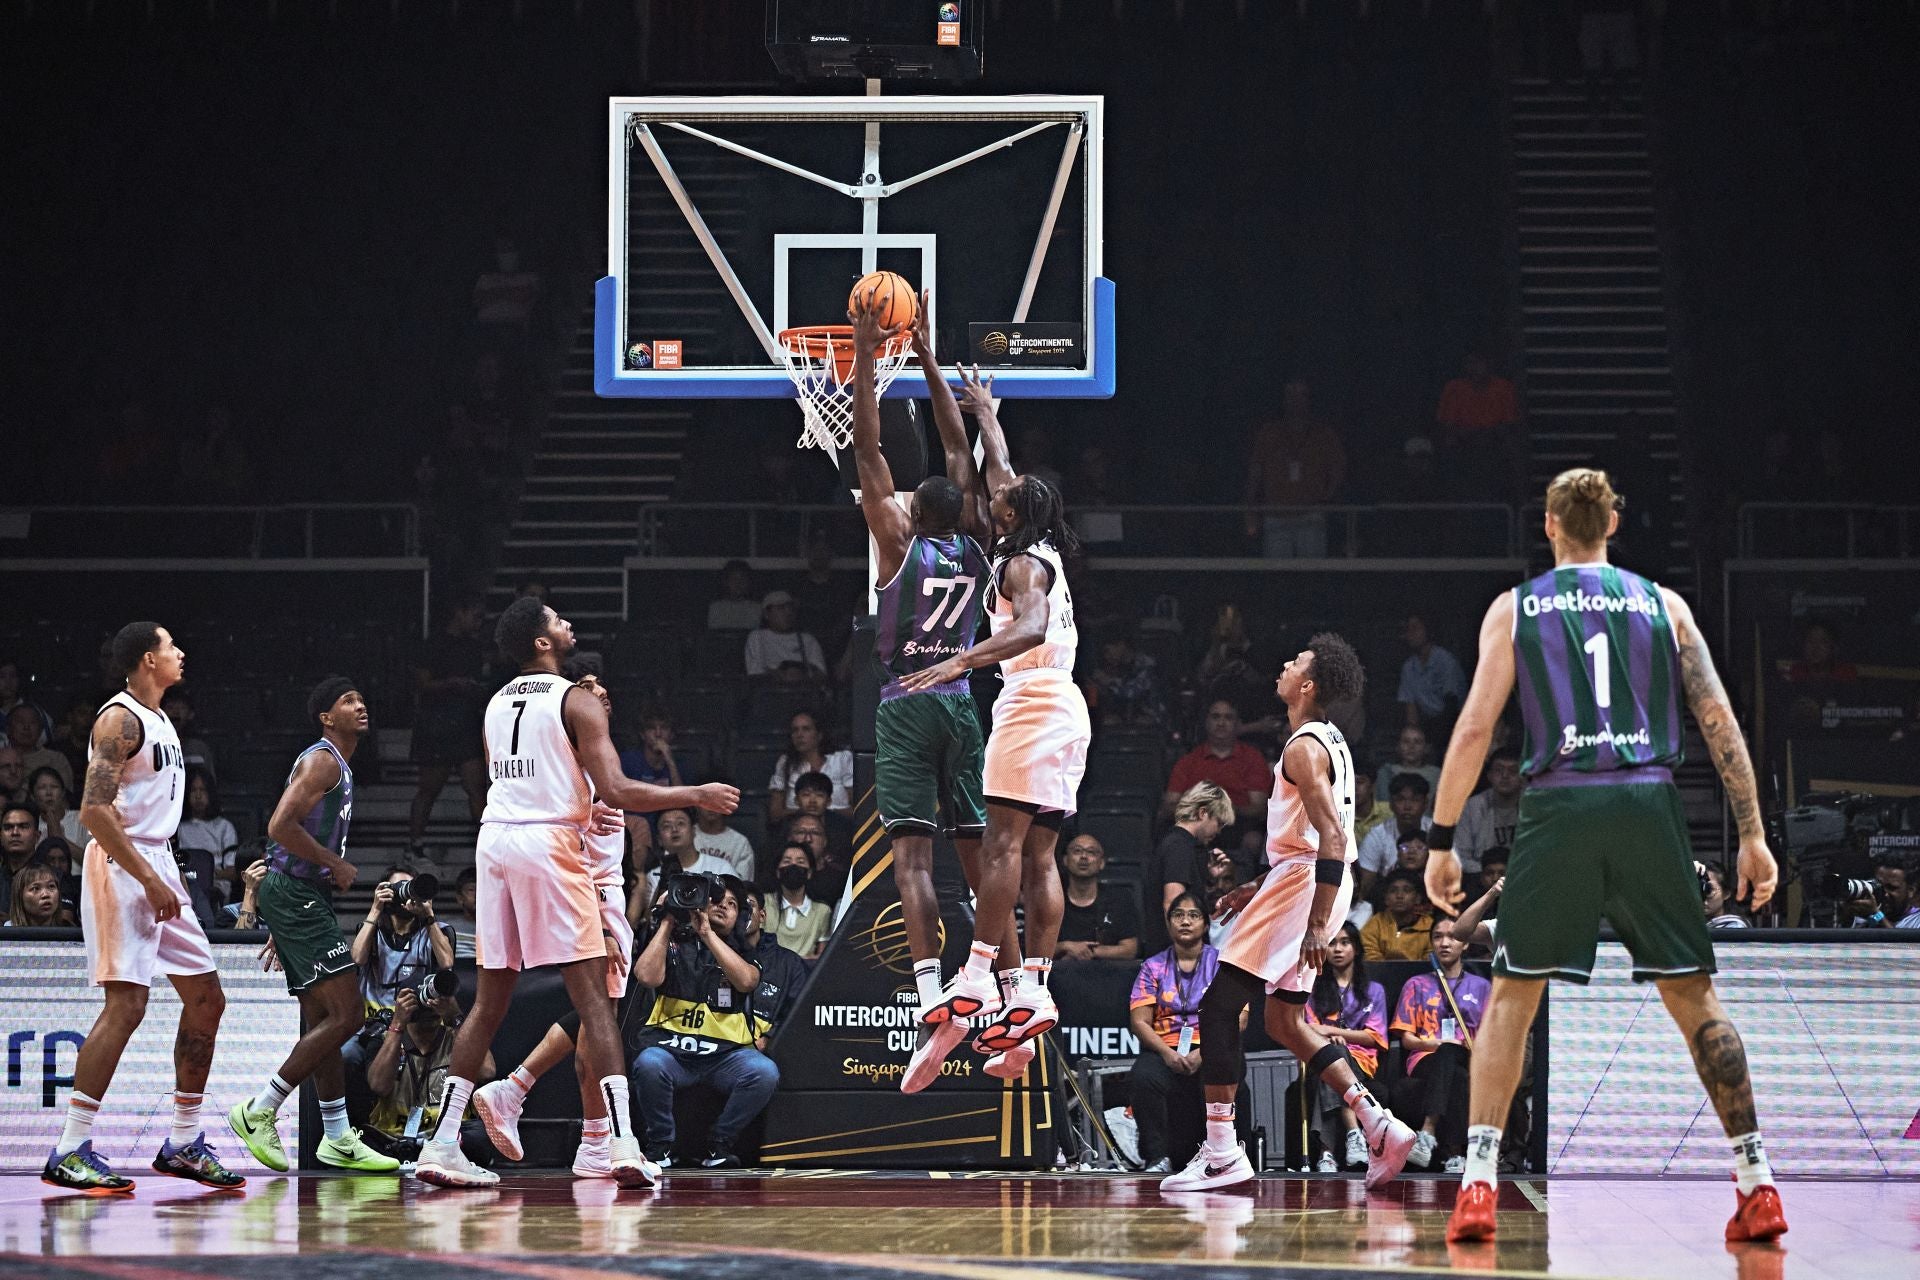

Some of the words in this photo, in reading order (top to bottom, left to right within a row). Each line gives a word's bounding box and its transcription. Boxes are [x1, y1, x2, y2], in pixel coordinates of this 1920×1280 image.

[659, 344, 678, 353] FIBA
[1009, 338, 1074, 347] INTERCONTINENTAL
[1009, 347, 1024, 355] CUP
[922, 575, 976, 632] 77
[1522, 588, 1659, 617] Osetkowski
[1584, 632, 1611, 708] 1
[511, 700, 527, 755] 7
[494, 760, 524, 779] BAKER
[896, 992, 919, 1003] FIBA
[681, 1008, 706, 1029] HB
